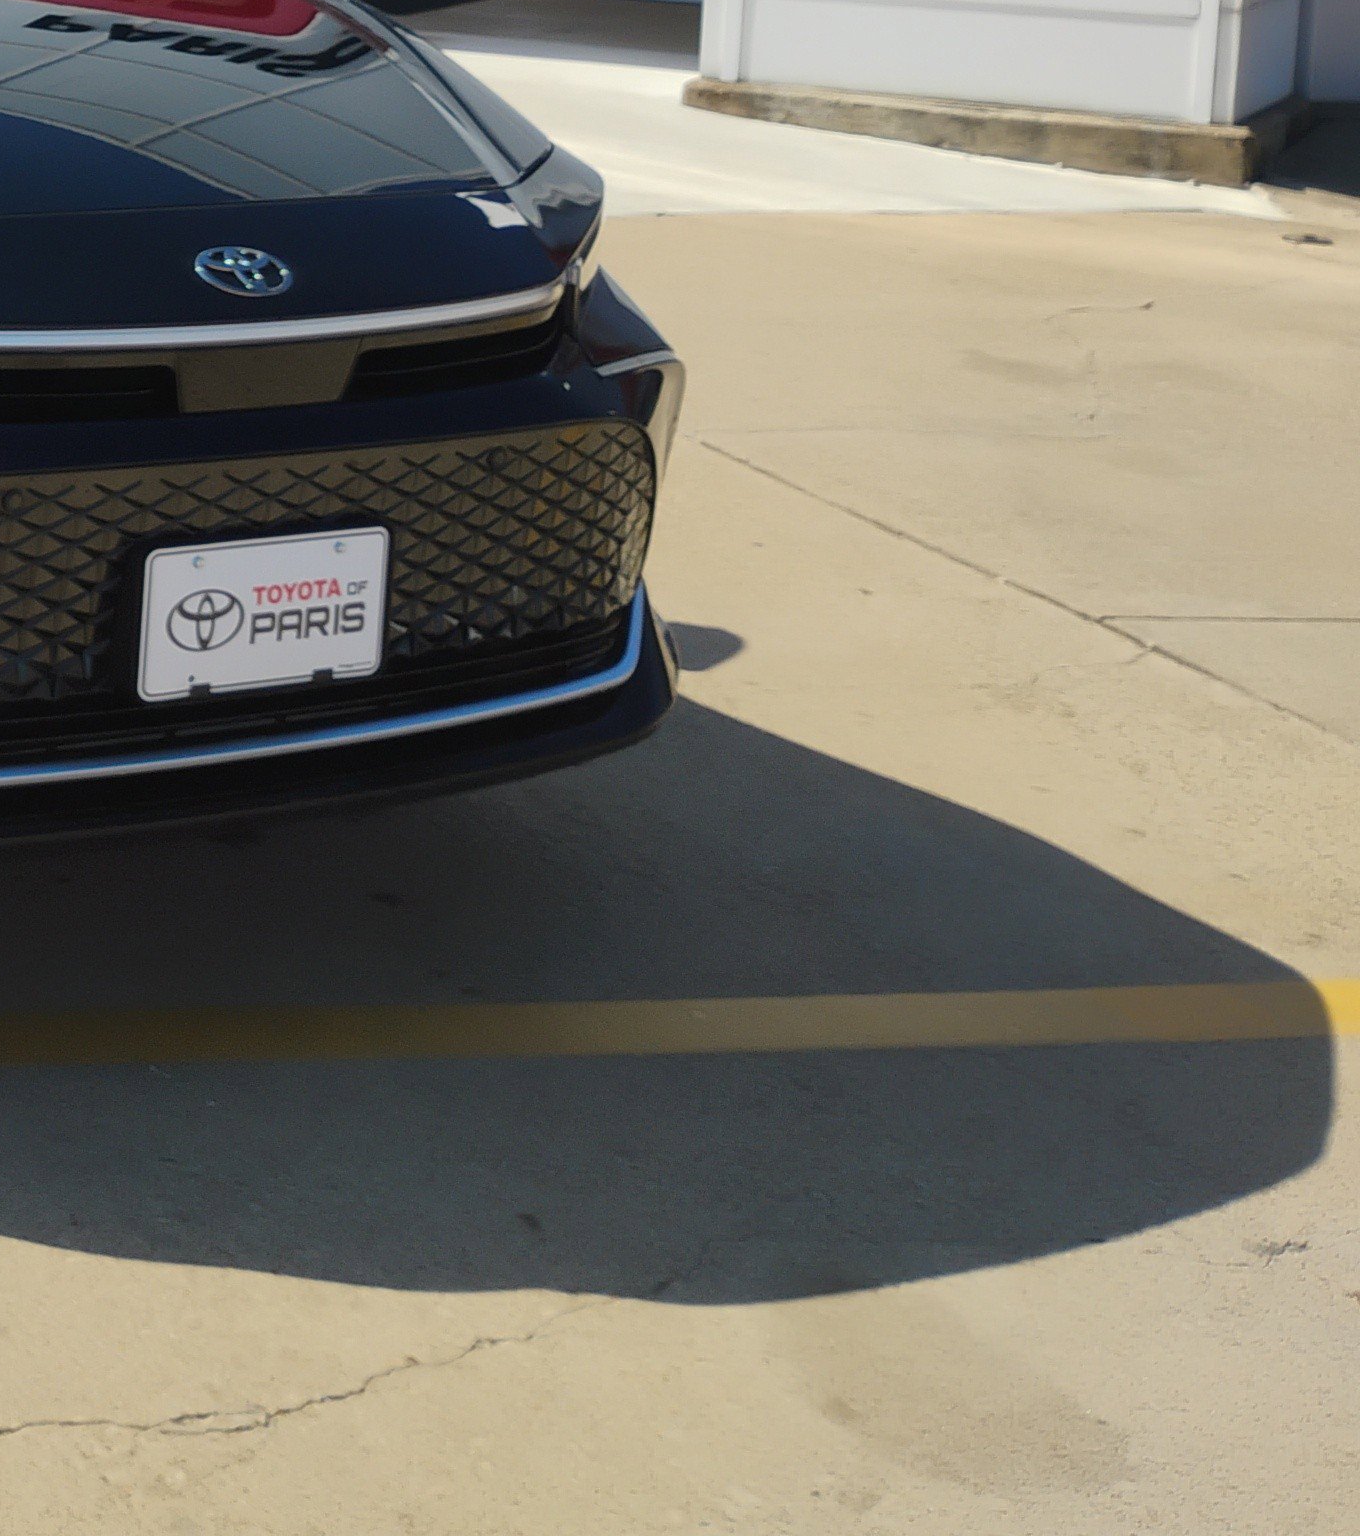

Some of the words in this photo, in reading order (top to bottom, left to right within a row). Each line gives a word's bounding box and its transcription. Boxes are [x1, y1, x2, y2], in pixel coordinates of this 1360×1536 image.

[252, 578, 343, 606] TOYOTA
[346, 580, 368, 596] OF
[249, 601, 366, 645] PARIS
